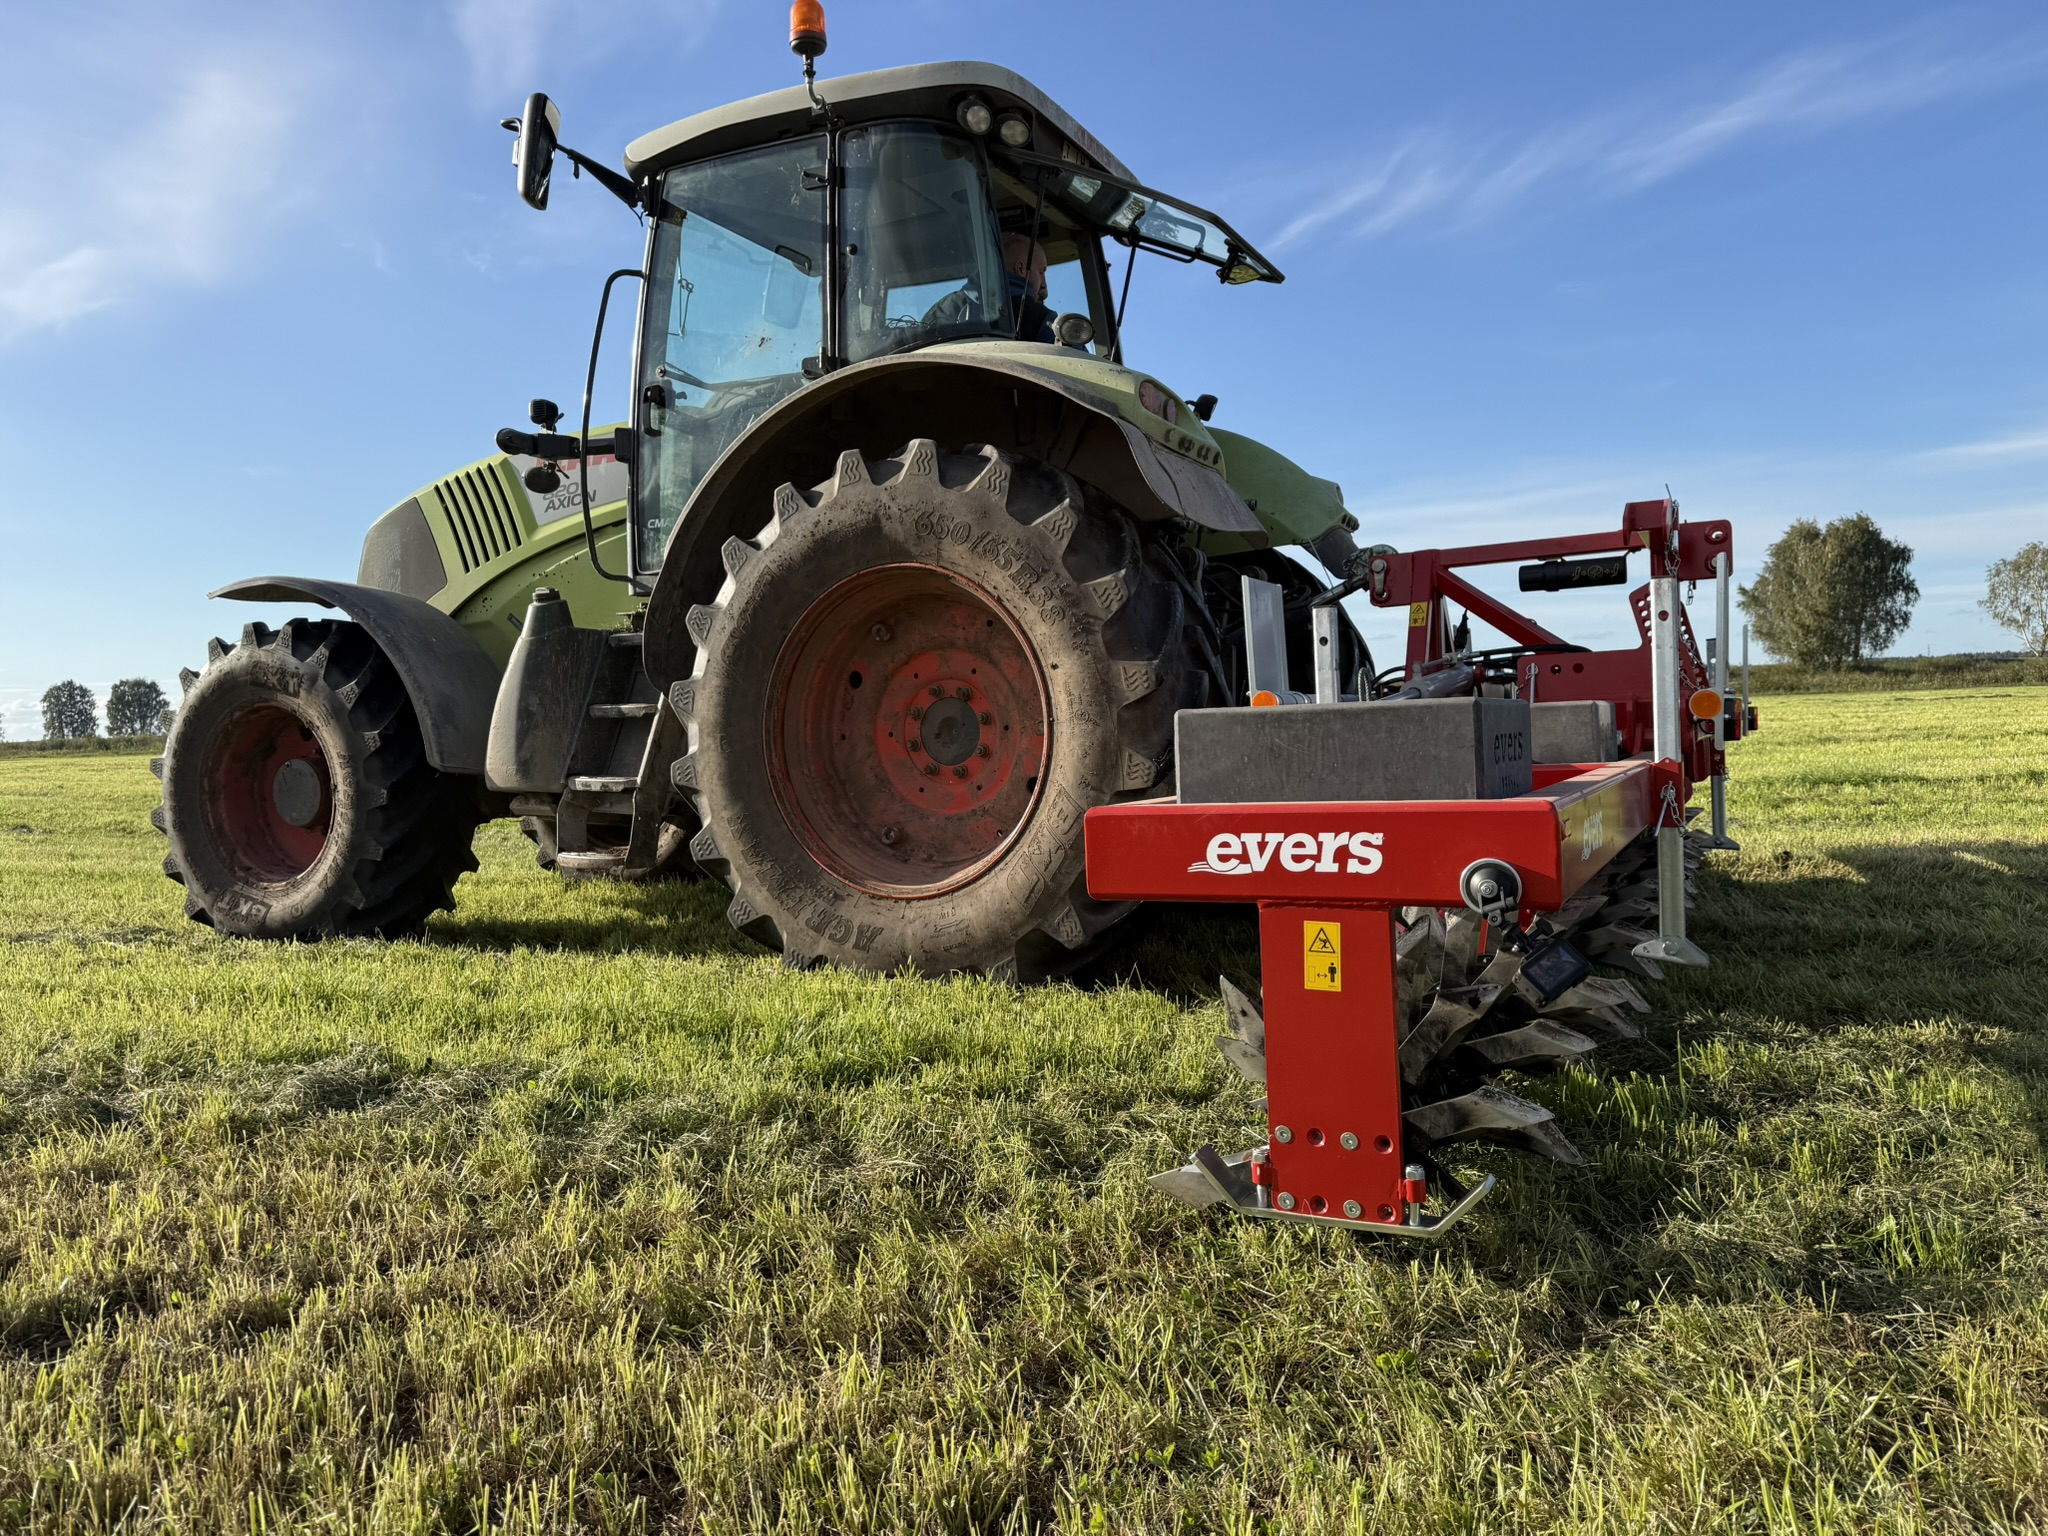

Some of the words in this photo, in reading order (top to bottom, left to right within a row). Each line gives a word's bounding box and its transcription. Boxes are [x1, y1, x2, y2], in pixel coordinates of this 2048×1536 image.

[544, 489, 596, 513] AXION
[1494, 731, 1523, 765] evers
[1188, 831, 1384, 875] evers
